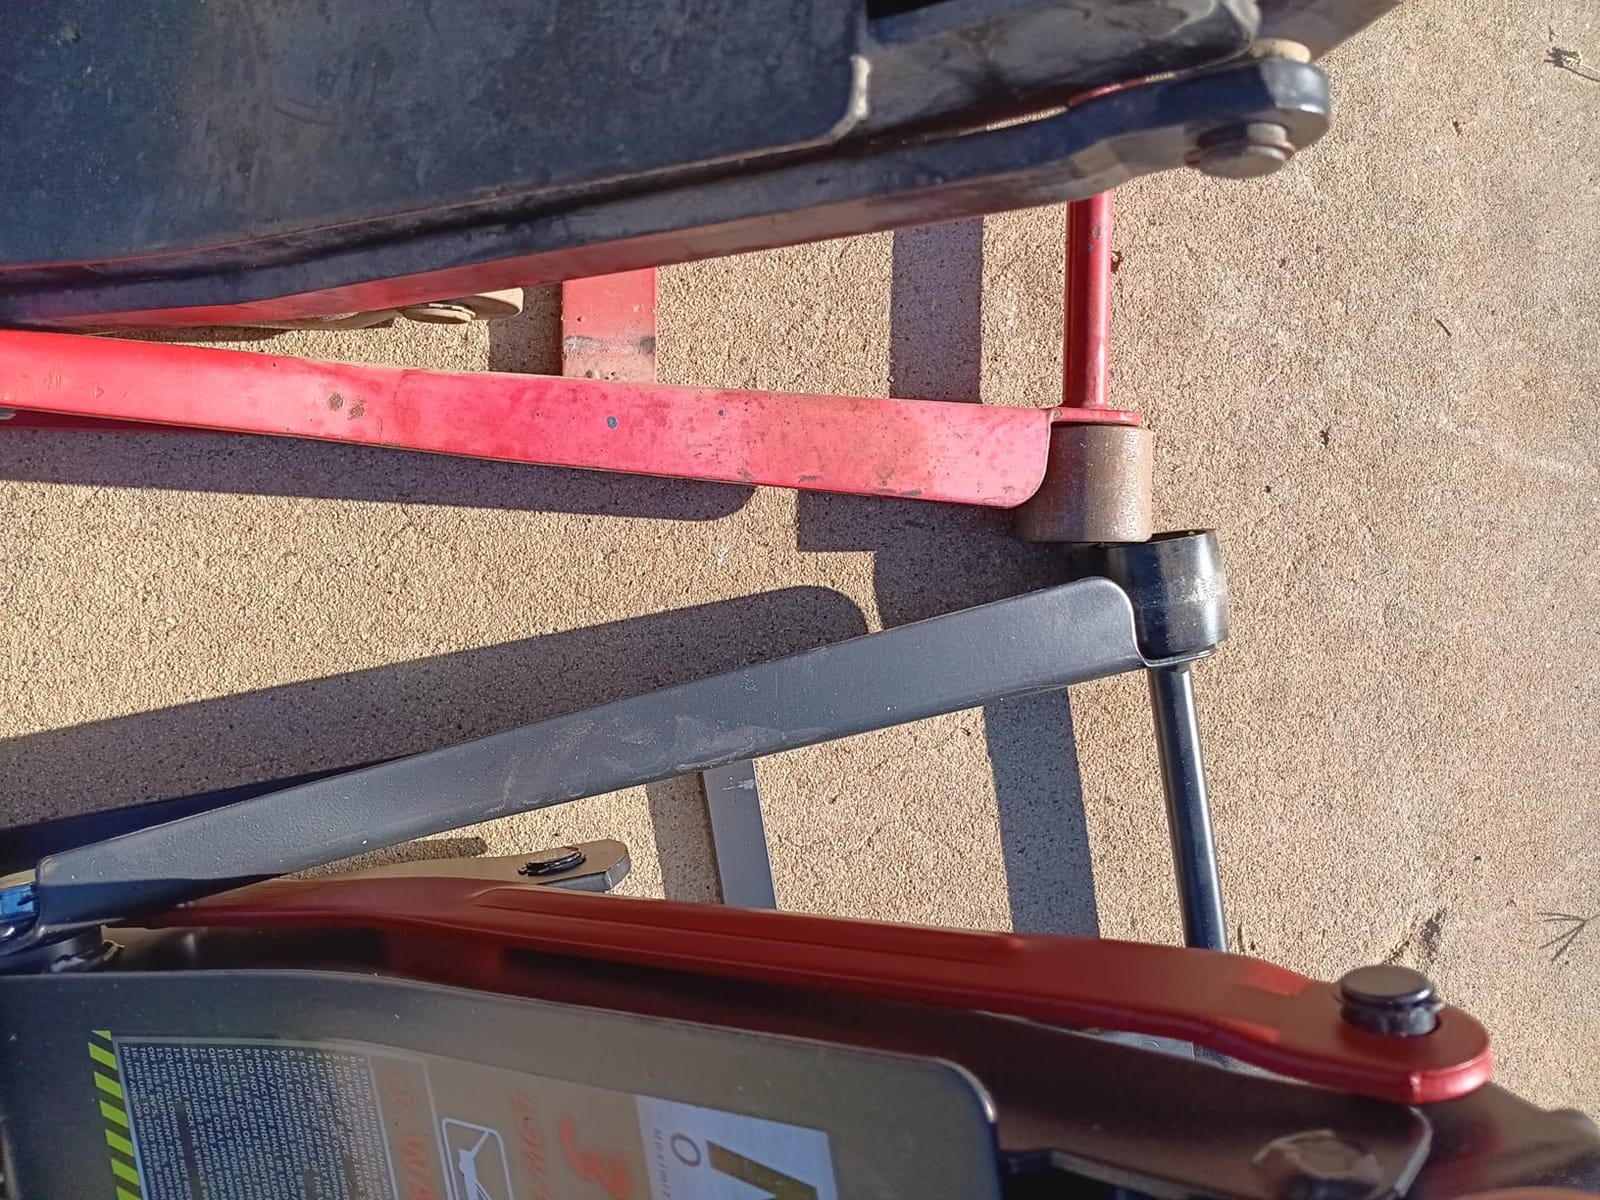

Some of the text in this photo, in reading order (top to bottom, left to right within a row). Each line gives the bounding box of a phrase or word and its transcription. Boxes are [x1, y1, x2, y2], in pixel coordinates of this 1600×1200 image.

[150, 1064, 161, 1085] THIS
[159, 1064, 169, 1082] THE
[220, 1064, 230, 1083] USE
[235, 1049, 246, 1077] UNTIL
[264, 1060, 276, 1085] ONLY
[280, 1050, 294, 1089] VEHICLE
[290, 1062, 301, 1081] LIFT
[307, 1055, 317, 1073] THE
[334, 1065, 344, 1084] USE
[179, 1079, 189, 1099] NOT
[197, 1080, 207, 1099] NOT
[249, 1076, 260, 1096] NOT
[295, 1084, 306, 1109] ONLY
[303, 1079, 313, 1099] NOT
[311, 1076, 325, 1116] VEHICLE
[325, 1061, 340, 1106] DEGREES
[122, 1047, 135, 1080] INJURY
[129, 1081, 142, 1117] AND/OR
[136, 1119, 152, 1167] PROPERTY
[163, 1084, 181, 1138] FOLLOWING
[182, 1048, 203, 1123] MANUFACTURER
[197, 1125, 213, 1172] SPECIFIED
[201, 1102, 211, 1120] USE
[208, 1048, 224, 1098] OPPOSING
[218, 1100, 232, 1138] WHEELS
[226, 1139, 240, 1176] BEFORE
[224, 1085, 237, 1117] WHEEL
[243, 1091, 253, 1110] HAS
[253, 1049, 275, 1127] MANUFACTURER
[269, 1128, 281, 1158] SHALL
[253, 1098, 264, 1117] GET
[316, 1064, 331, 1101] LIFTING
[325, 1104, 338, 1137] DEVICE
[338, 1087, 350, 1112] ONLY
[133, 1063, 147, 1099] FAILURE
[143, 1116, 155, 1141] HEED
[149, 1144, 161, 1173] THESE
[183, 1101, 195, 1127] ROCK
[202, 1064, 215, 1095] NEVER
[209, 1096, 219, 1115] USE
[218, 1141, 230, 1168] LAWN
[229, 1064, 243, 1103] CENTER
[237, 1104, 248, 1129] LOAD
[246, 1147, 260, 1183] SADDLE
[247, 1112, 259, 1136] BEEN
[269, 1087, 289, 1155] ATTACHMENTS
[276, 1077, 296, 1141] ALTERATIONS
[290, 1143, 302, 1173] SHALL
[307, 1102, 319, 1129] MOVE
[189, 1129, 199, 1148] THE
[205, 1122, 216, 1144] THIS
[231, 1119, 246, 1159] CHOCKS
[258, 1119, 271, 1152] UNDER
[303, 1127, 317, 1159] AREAS
[319, 1118, 331, 1144] WITH
[346, 1084, 356, 1104] NOT
[351, 1107, 364, 1144] EXCEED
[359, 1147, 371, 1177] RATED
[174, 1139, 185, 1158] ARE
[210, 1146, 221, 1169] JACK
[178, 1159, 189, 1179] NOT
[193, 1149, 207, 1187] VEHICLE
[253, 1139, 271, 1196] SUPPORTED
[316, 1147, 329, 1178] DOLLY
[162, 1167, 173, 1187] NOR
[215, 1171, 226, 1190] FOR
[283, 1157, 297, 1195] AND/OR
[313, 1176, 324, 1195] THE
[323, 1180, 333, 1198] THE
[353, 1164, 365, 1192] LEVEL
